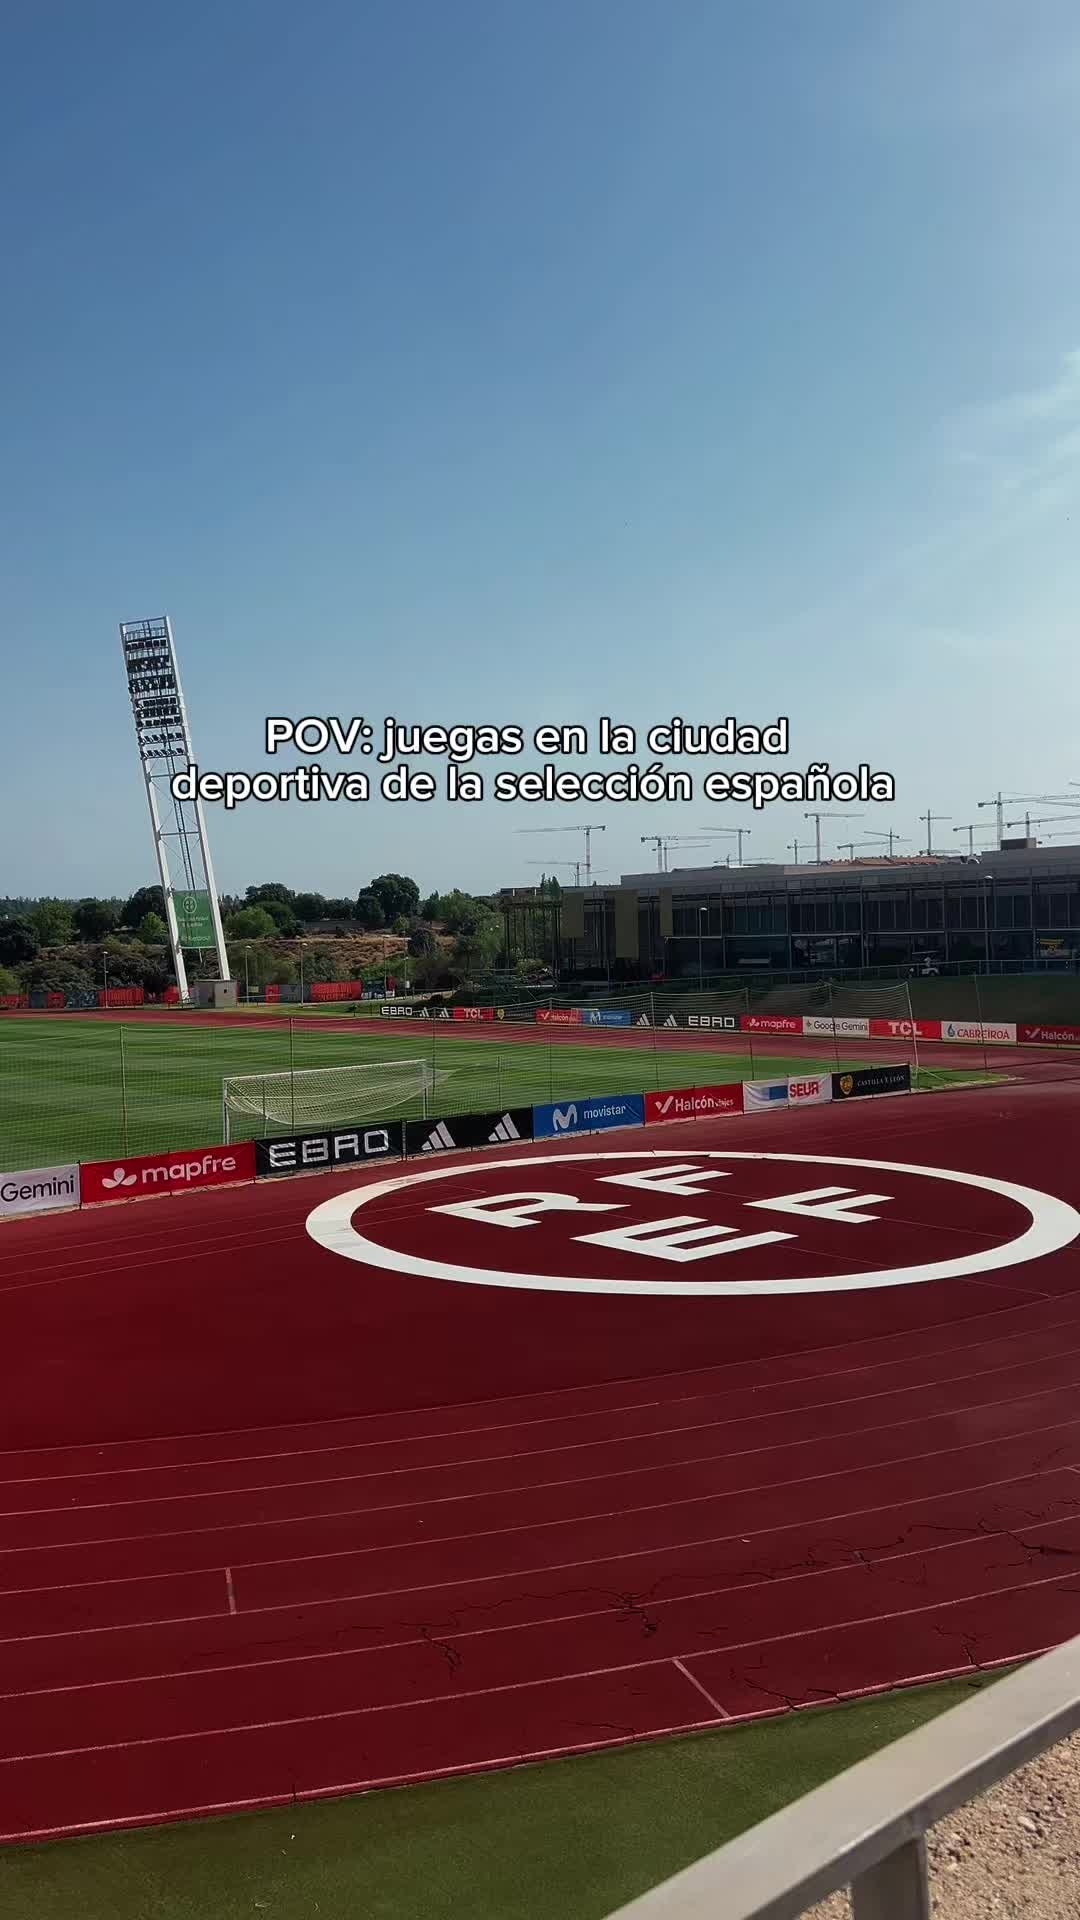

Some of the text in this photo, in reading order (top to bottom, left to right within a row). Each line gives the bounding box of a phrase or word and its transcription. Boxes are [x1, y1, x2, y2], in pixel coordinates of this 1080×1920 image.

[381, 1006, 413, 1016] EBRO
[688, 1015, 735, 1028] EBRO
[760, 1019, 796, 1030] mapfre
[813, 1020, 869, 1032] Googe Gemini
[887, 1021, 923, 1035] TCL
[1041, 1031, 1075, 1041] Halcón
[789, 1081, 820, 1097] SEUR
[675, 1096, 714, 1112] Halcón
[583, 1104, 627, 1120] movistar
[269, 1129, 390, 1168] EBRO
[142, 1154, 236, 1184] mapfre
[1, 1174, 74, 1202] Gemini
